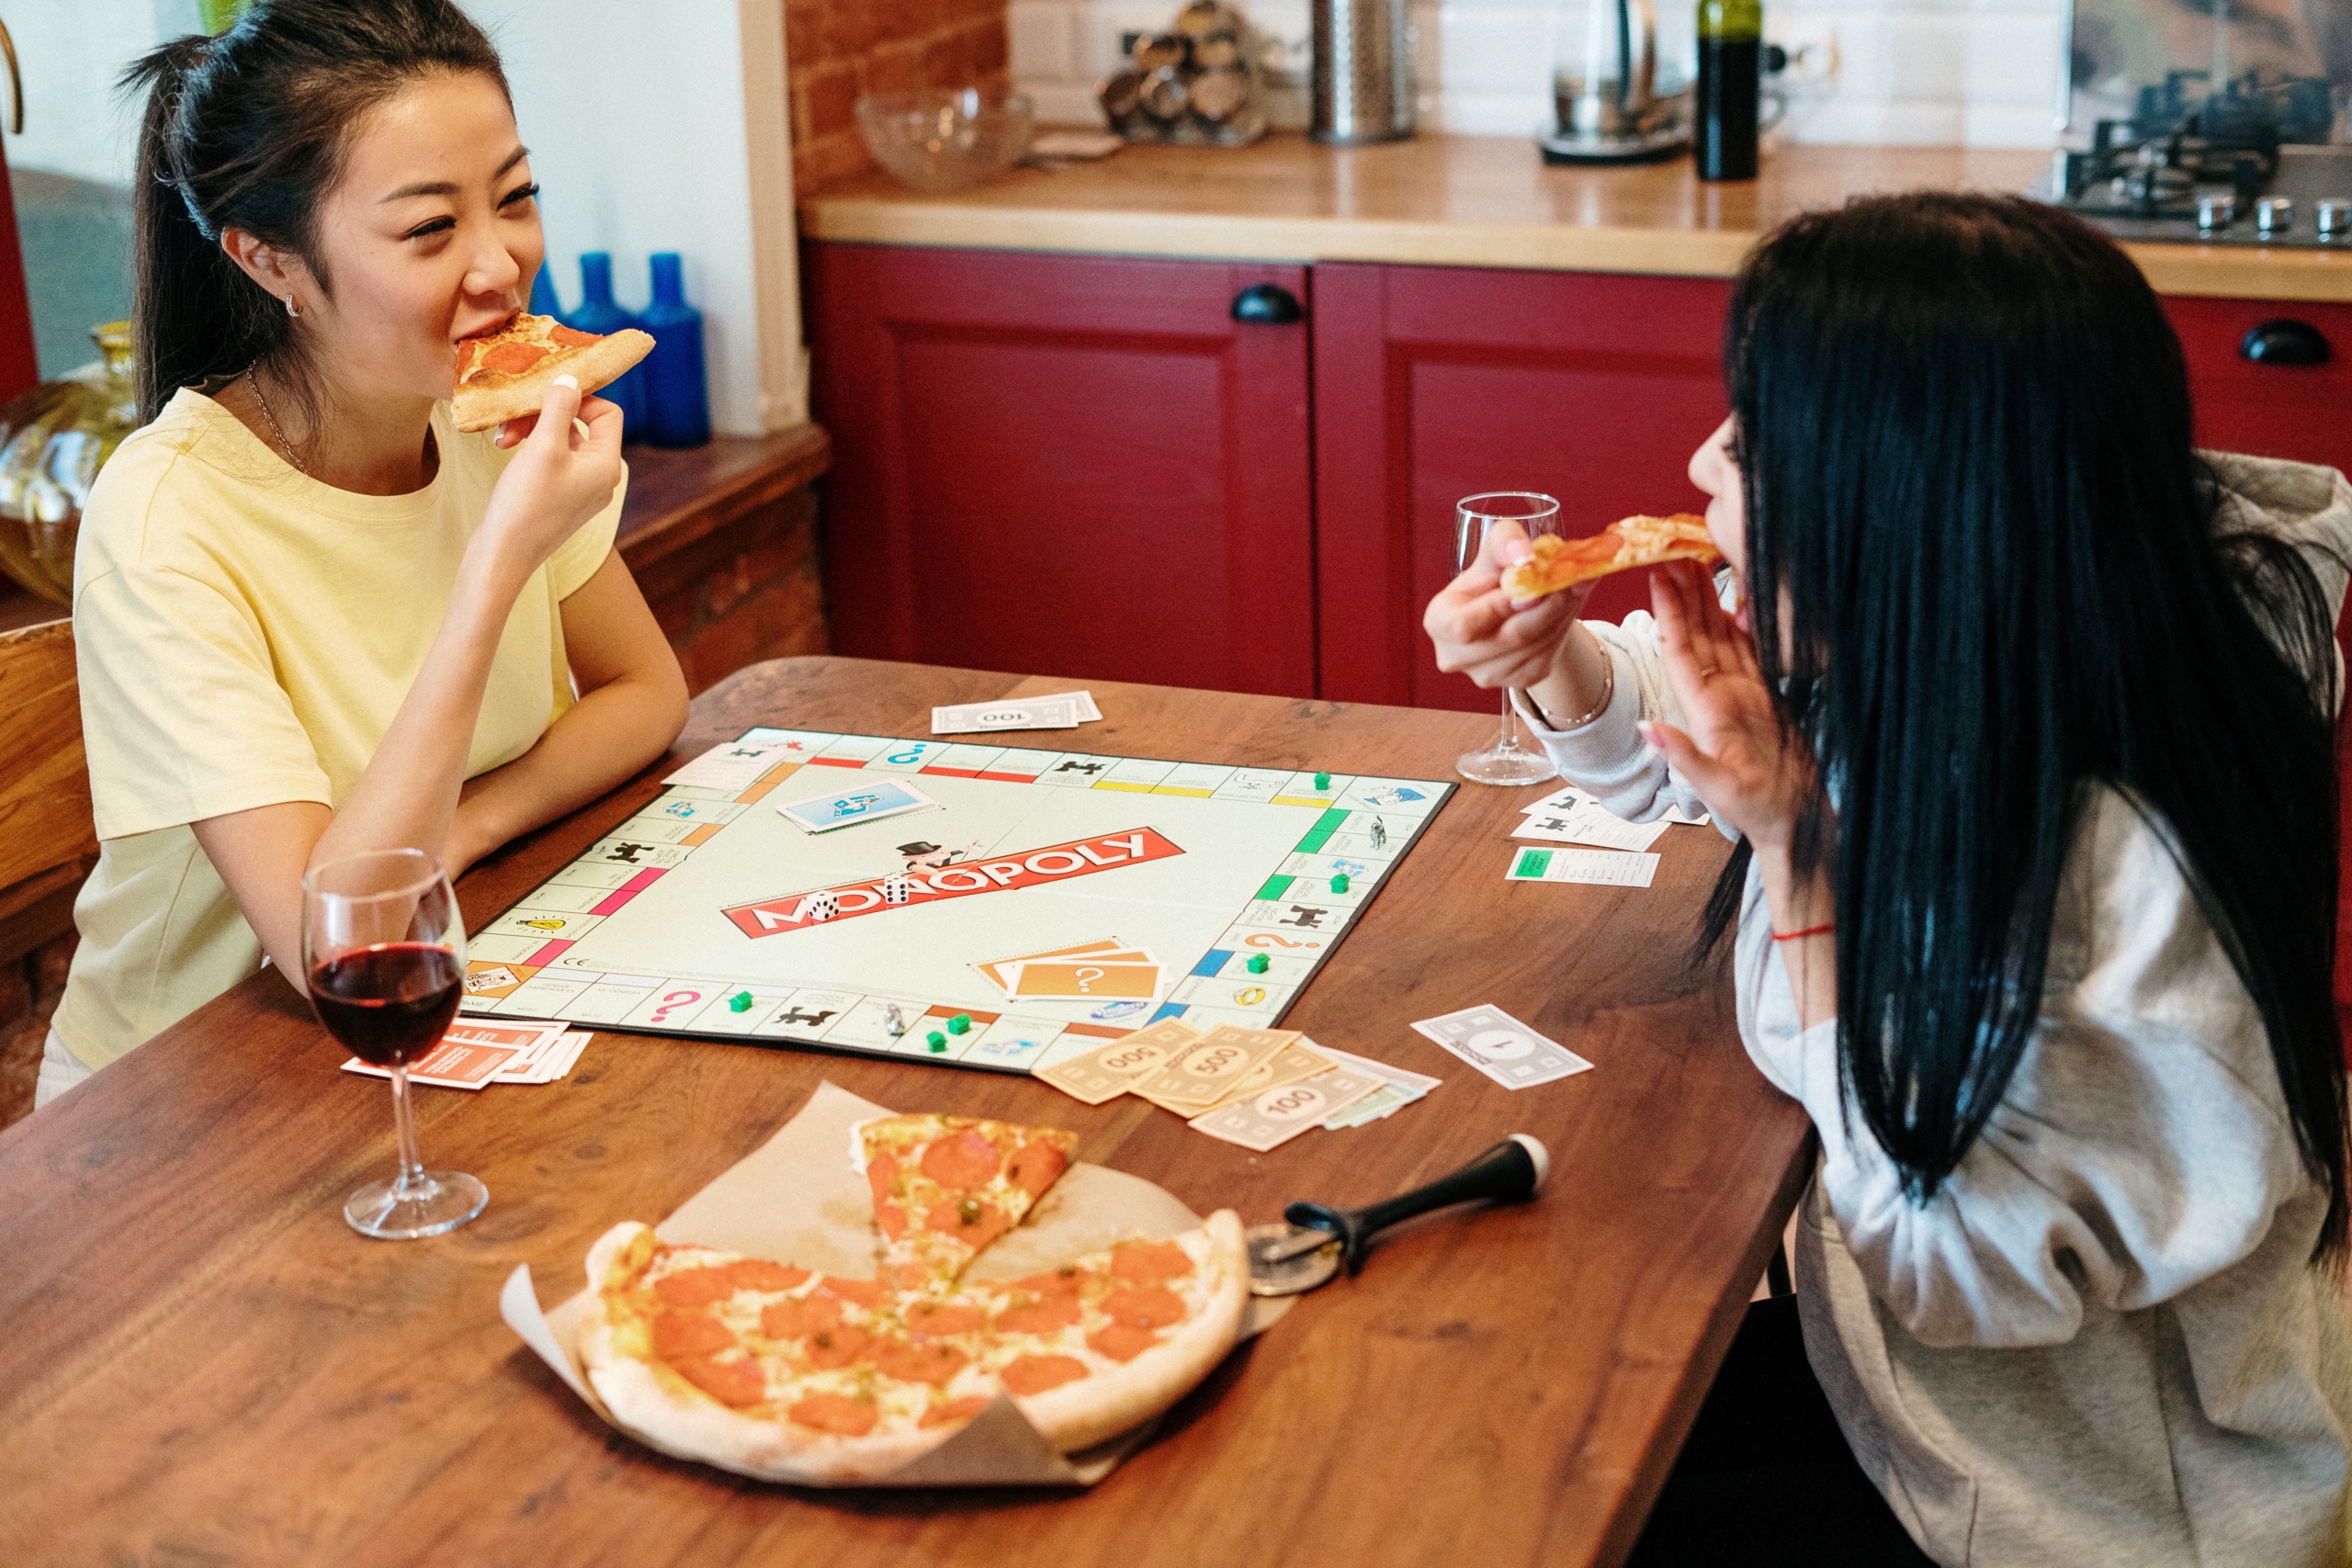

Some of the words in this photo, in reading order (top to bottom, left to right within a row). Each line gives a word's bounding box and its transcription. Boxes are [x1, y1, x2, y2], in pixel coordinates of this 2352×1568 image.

[1105, 1046, 1157, 1070] 500
[1193, 1047, 1239, 1075] 500
[1268, 1089, 1317, 1115] 100
